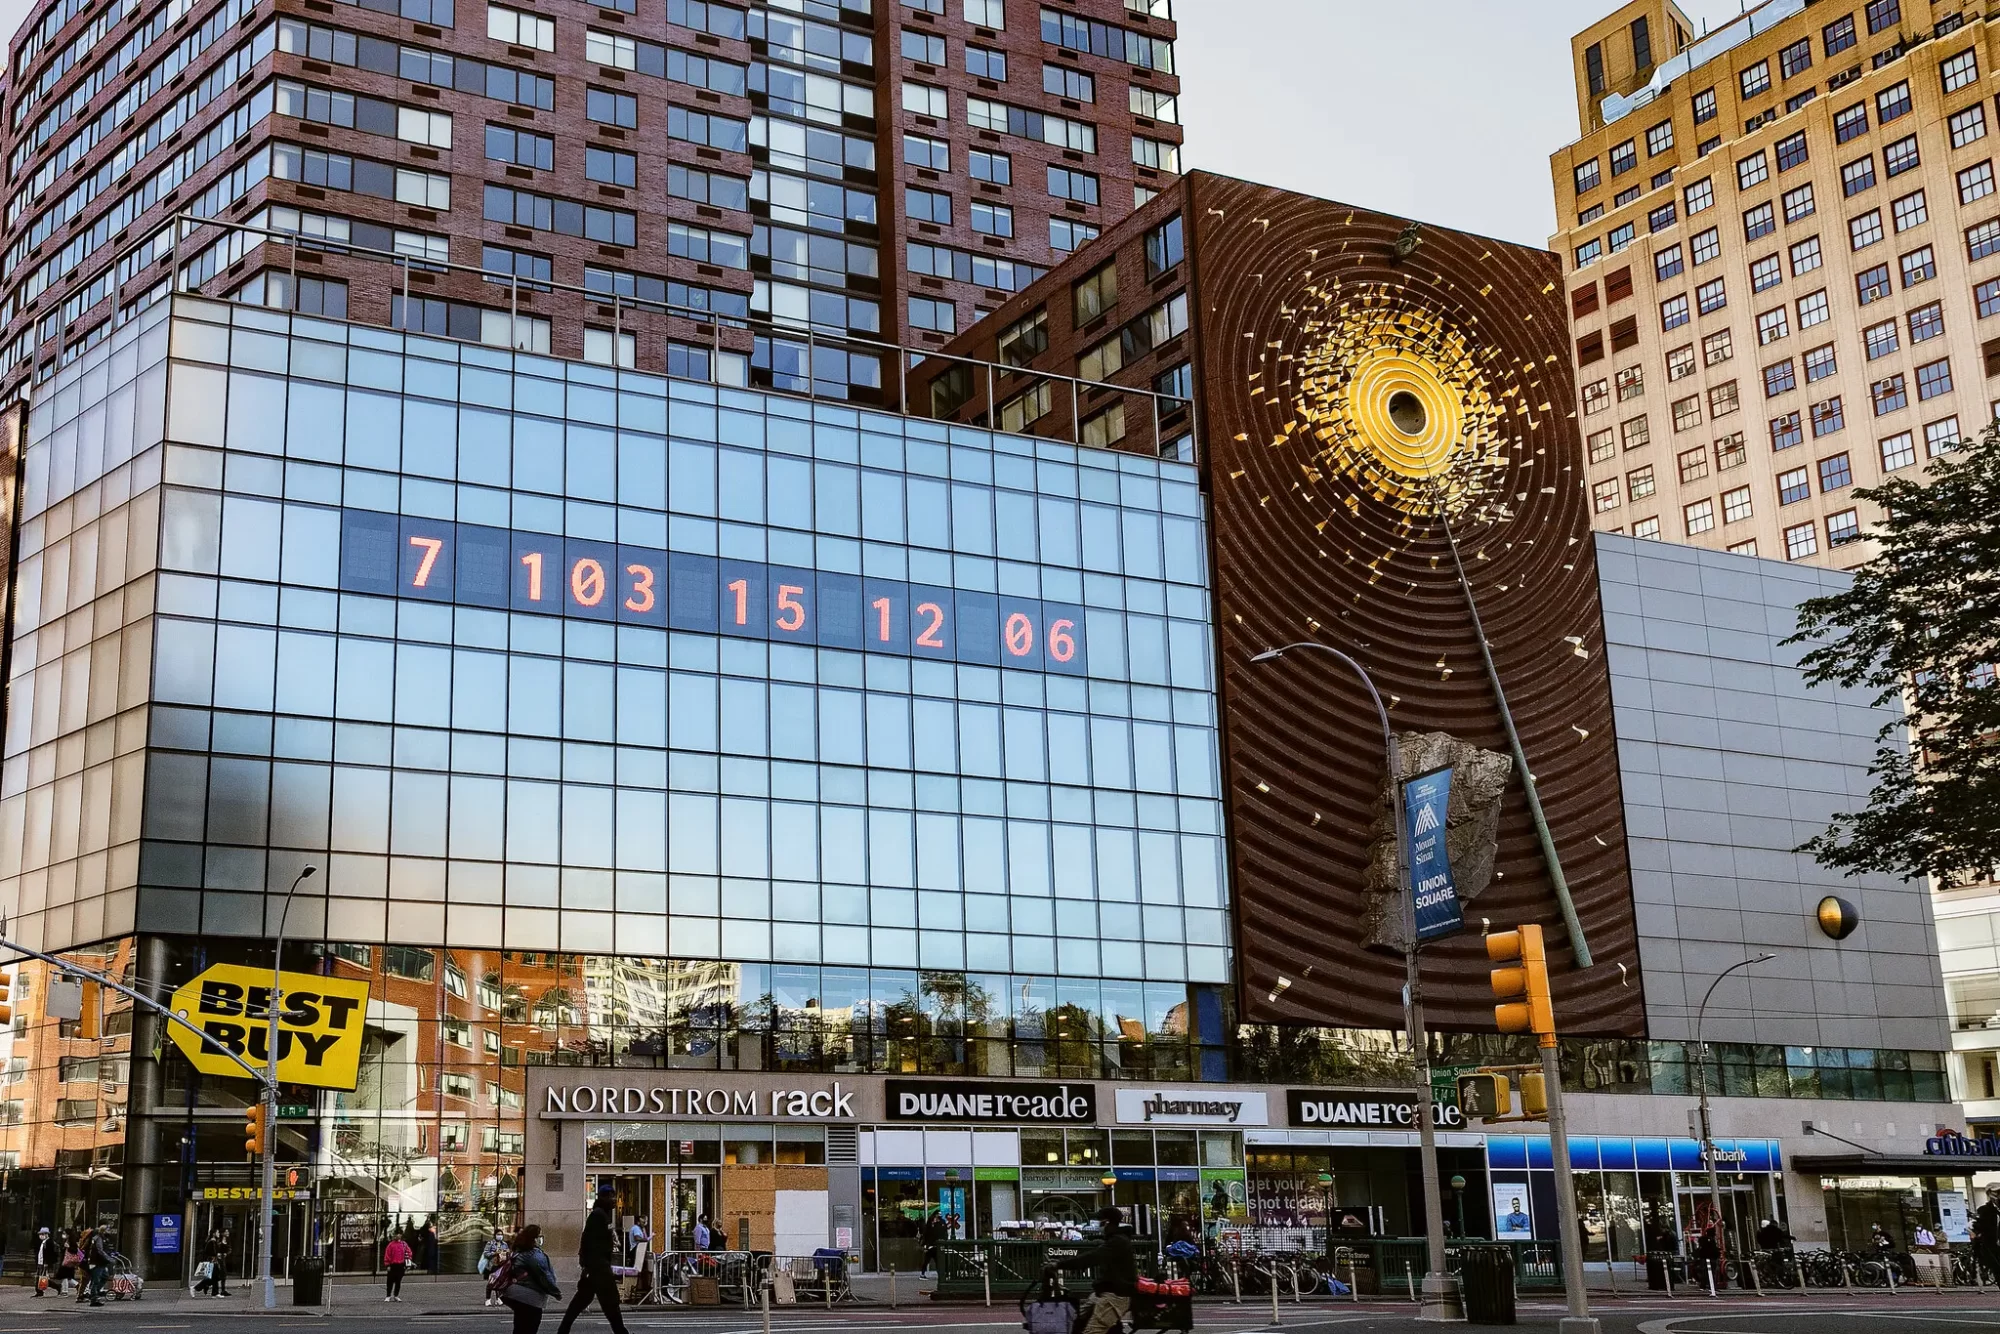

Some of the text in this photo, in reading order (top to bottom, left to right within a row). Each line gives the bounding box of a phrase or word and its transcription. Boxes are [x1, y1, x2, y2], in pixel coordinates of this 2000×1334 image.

[411, 538, 1074, 662] 7 103 15 12 06
[1415, 835, 1436, 853] Mount
[1416, 849, 1434, 864] Sinai
[1418, 873, 1447, 893] UNION
[1416, 886, 1455, 909] SQUARE
[198, 980, 359, 1030] BEST
[200, 1020, 342, 1067] BUY
[1432, 1069, 1452, 1078] Union
[546, 1081, 855, 1118] NORDSTROM rack
[1434, 1088, 1439, 1100] E
[1143, 1092, 1244, 1123] pharmacy
[1701, 1148, 1748, 1162] ctibank
[204, 1187, 253, 1199] BEST
[1247, 1179, 1306, 1194] get your
[1249, 1196, 1281, 1210] shot
[1048, 1247, 1078, 1257] Subway
